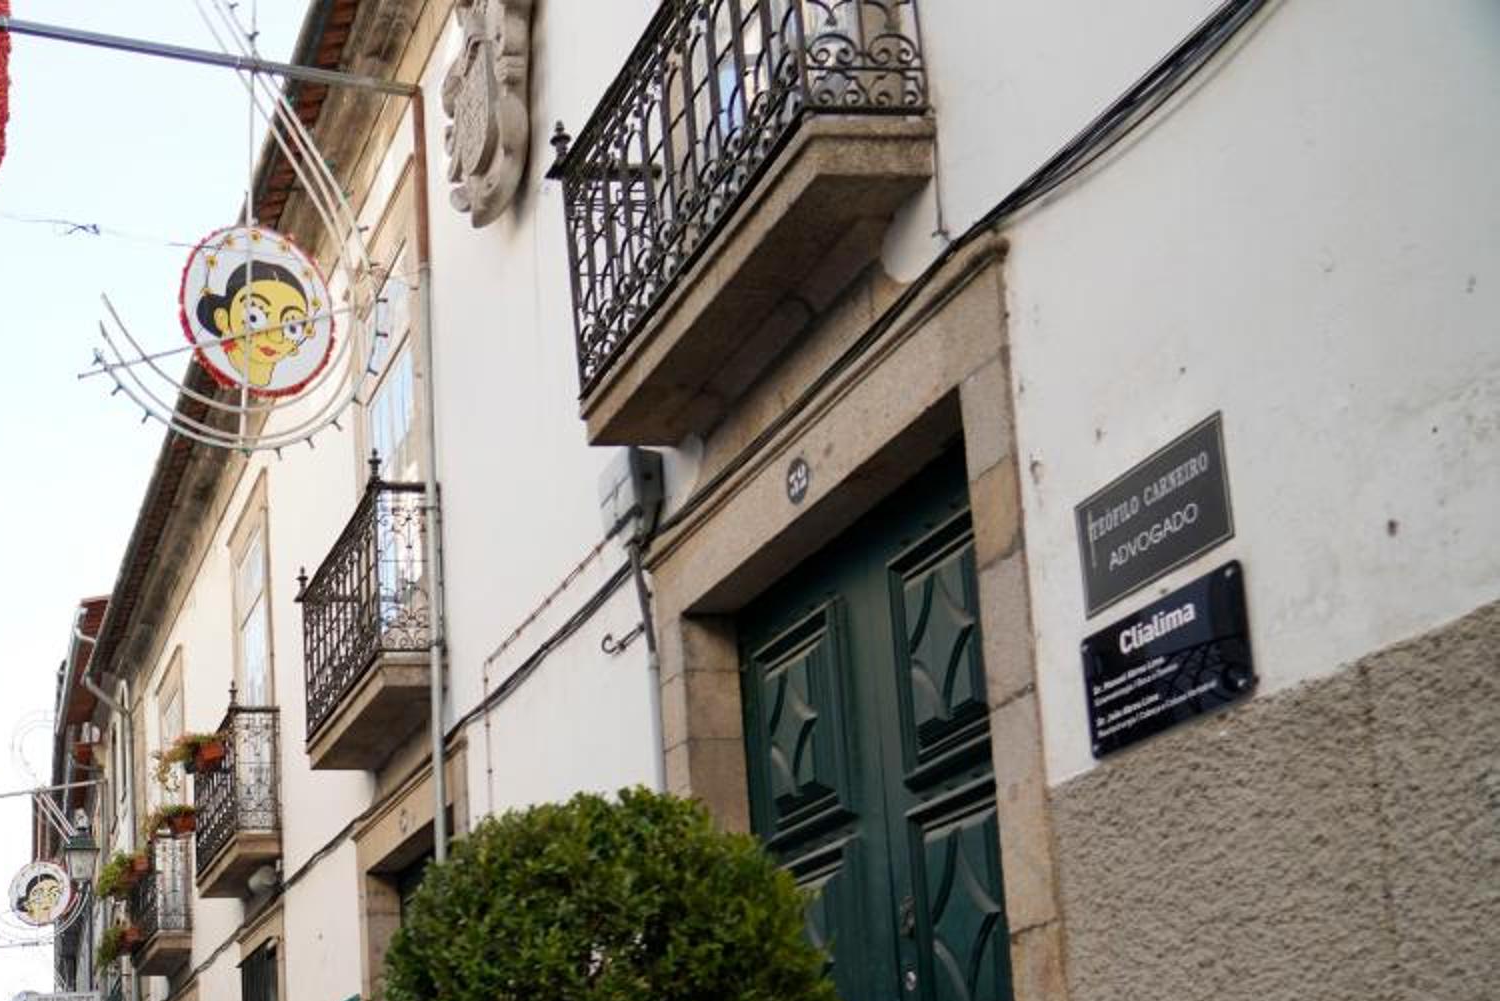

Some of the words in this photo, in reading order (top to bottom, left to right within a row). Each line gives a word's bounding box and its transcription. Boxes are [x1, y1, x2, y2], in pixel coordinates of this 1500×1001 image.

[1143, 451, 1208, 507] CARNEIRO
[1109, 502, 1199, 572] ADVOGADO
[1119, 602, 1197, 654] Clialima
